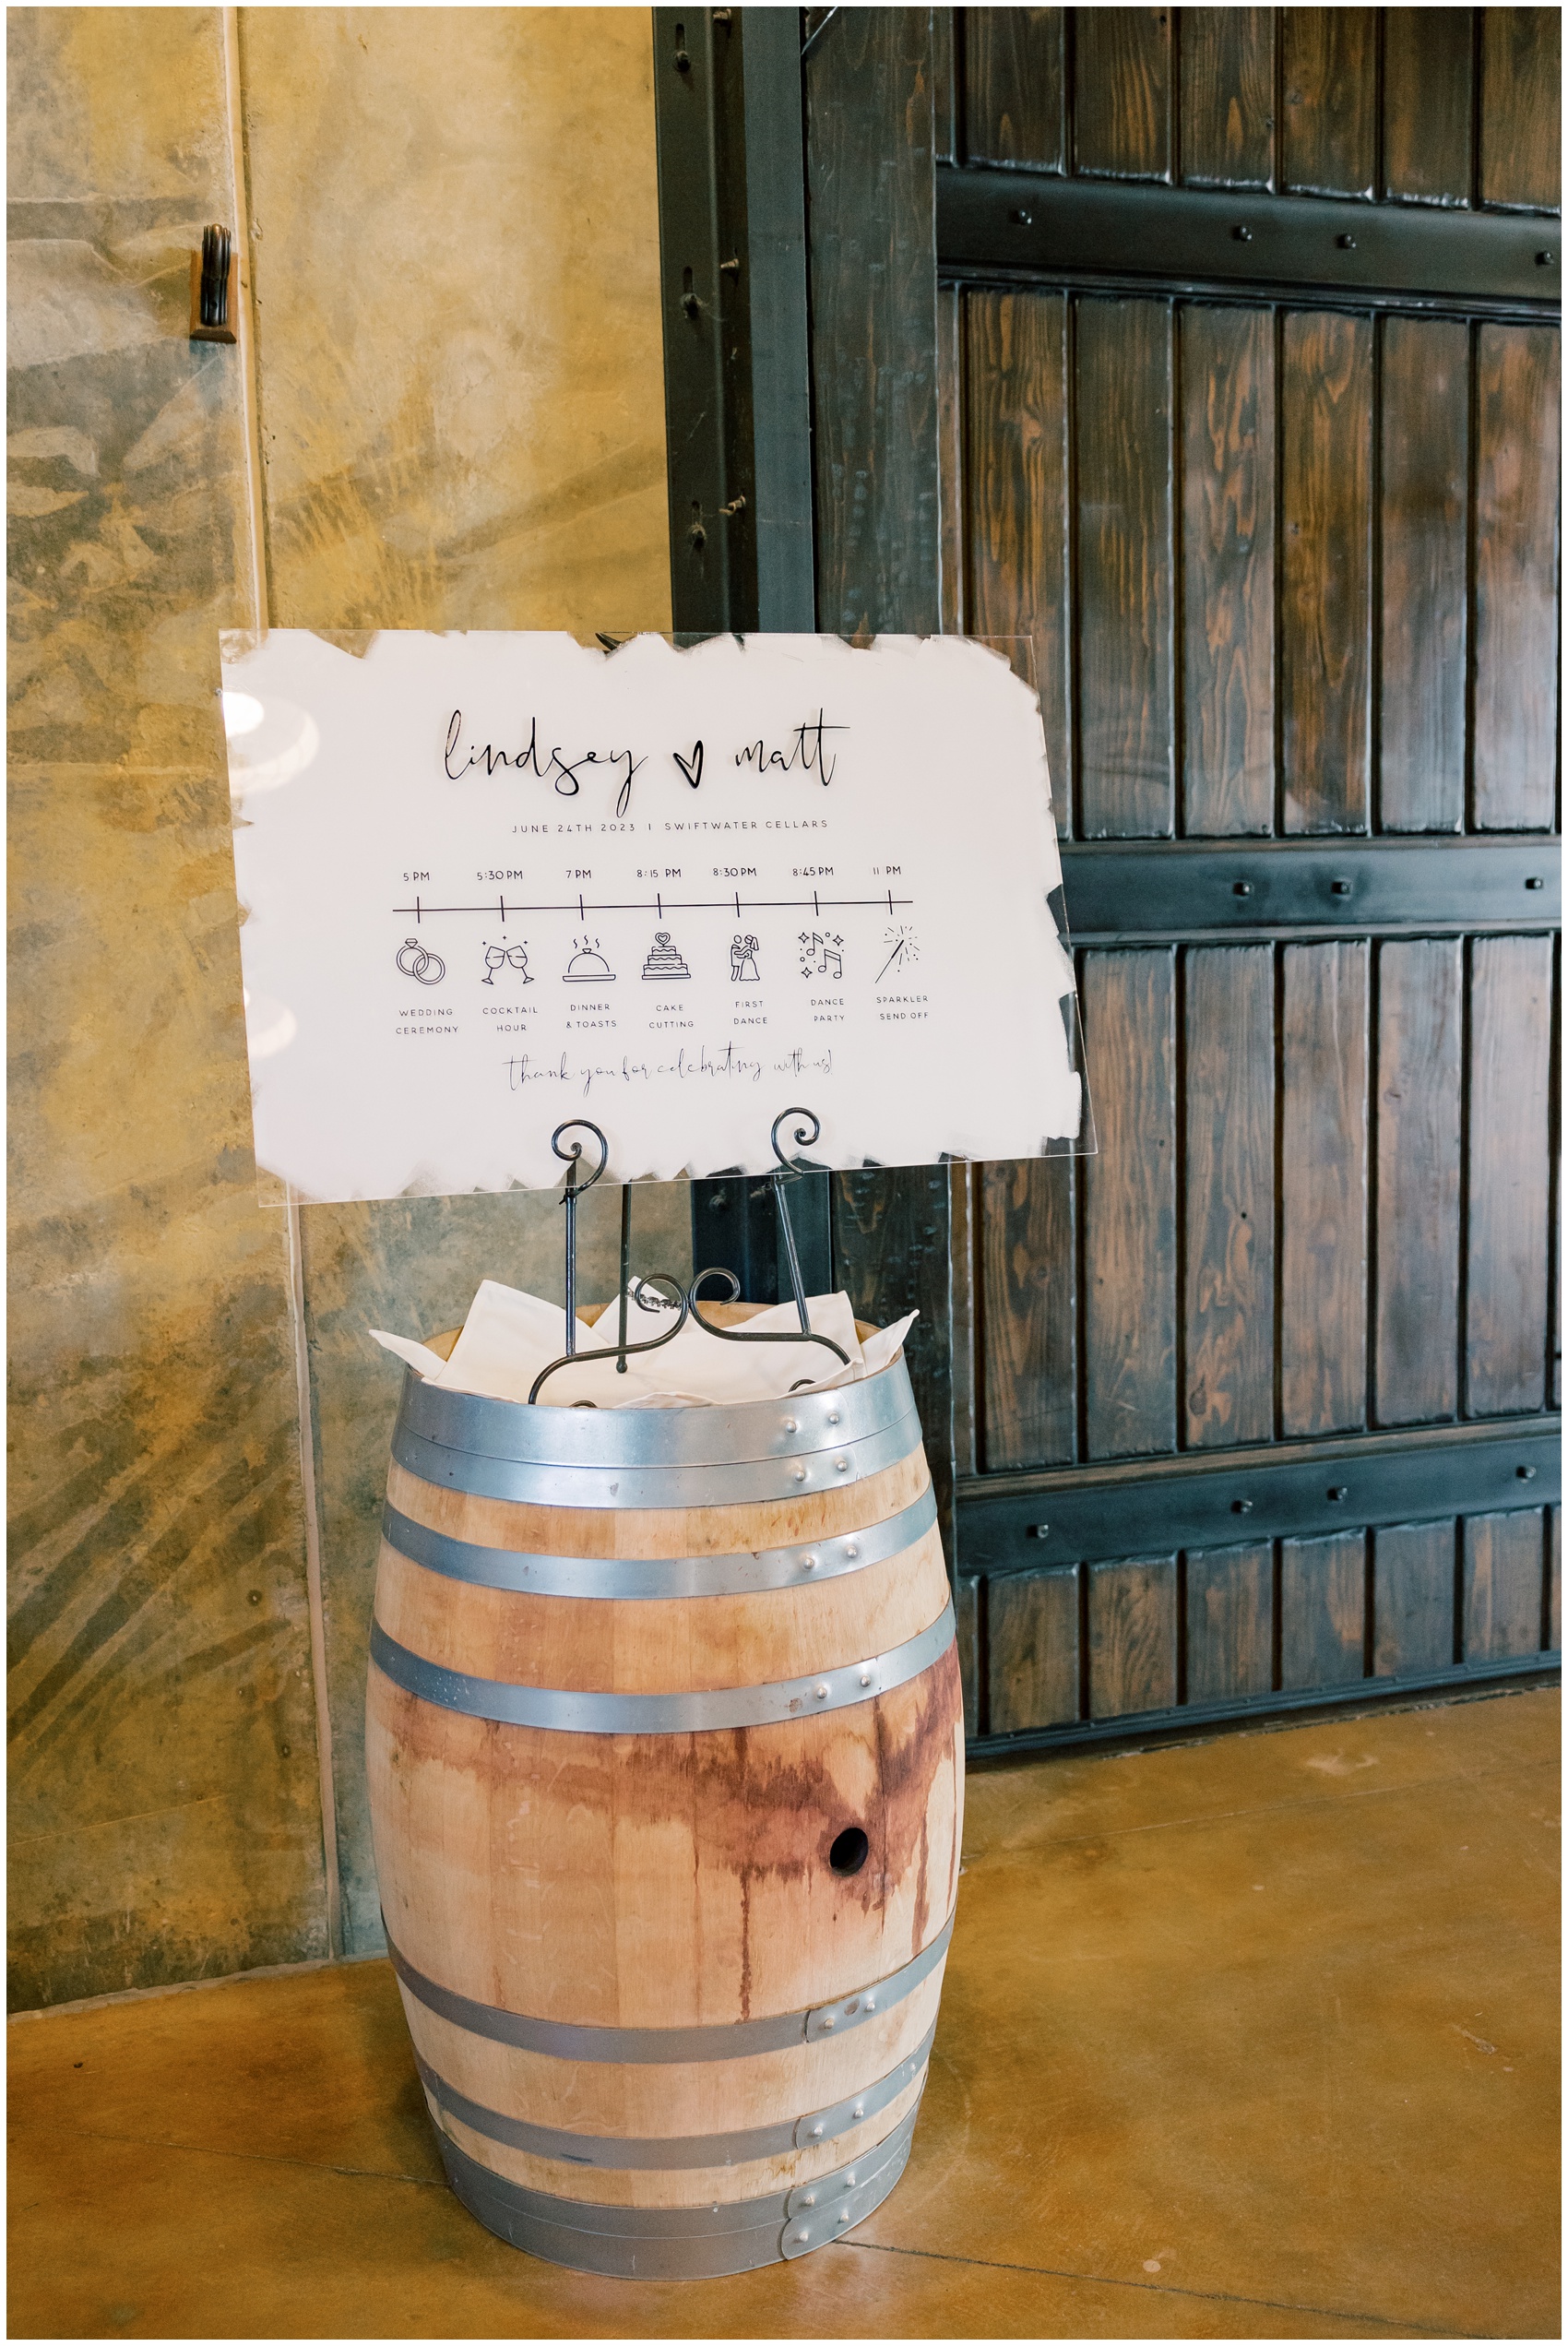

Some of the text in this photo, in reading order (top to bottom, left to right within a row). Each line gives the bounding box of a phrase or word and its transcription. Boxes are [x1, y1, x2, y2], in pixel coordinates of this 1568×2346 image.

[444, 708, 850, 818] lindsey matt
[511, 824, 549, 833] JUNE
[557, 824, 593, 833] 24TH
[600, 823, 636, 832] 2023
[664, 821, 758, 831] SWIFTWATER
[765, 819, 829, 829] CELLARS
[565, 869, 592, 879] 7 PM
[665, 867, 682, 878] PM
[713, 867, 757, 877] 8:30 PM
[792, 866, 835, 876] 8:45 PM
[885, 865, 902, 875] PM
[403, 871, 431, 882] 5 PM
[476, 870, 524, 881] 5:30 PM
[735, 1000, 764, 1008] FIRST
[811, 998, 845, 1006] DANCE
[876, 995, 929, 1004] SPARKLER
[398, 1008, 454, 1017] WEDDING
[482, 1006, 539, 1015] COCKTAIL
[570, 1004, 611, 1012] DINNER
[879, 1011, 929, 1020] SEND OFF
[576, 1019, 617, 1029] TOASTS
[648, 1021, 695, 1030] CUTTING
[733, 1017, 768, 1025] DANCE
[396, 1026, 459, 1035] CEREMONY
[496, 1024, 528, 1032] HOUR
[504, 1052, 575, 1091] thank
[580, 1067, 616, 1098] you
[622, 1055, 651, 1082] for
[657, 1041, 766, 1082] celebrating
[773, 1047, 809, 1078] with
